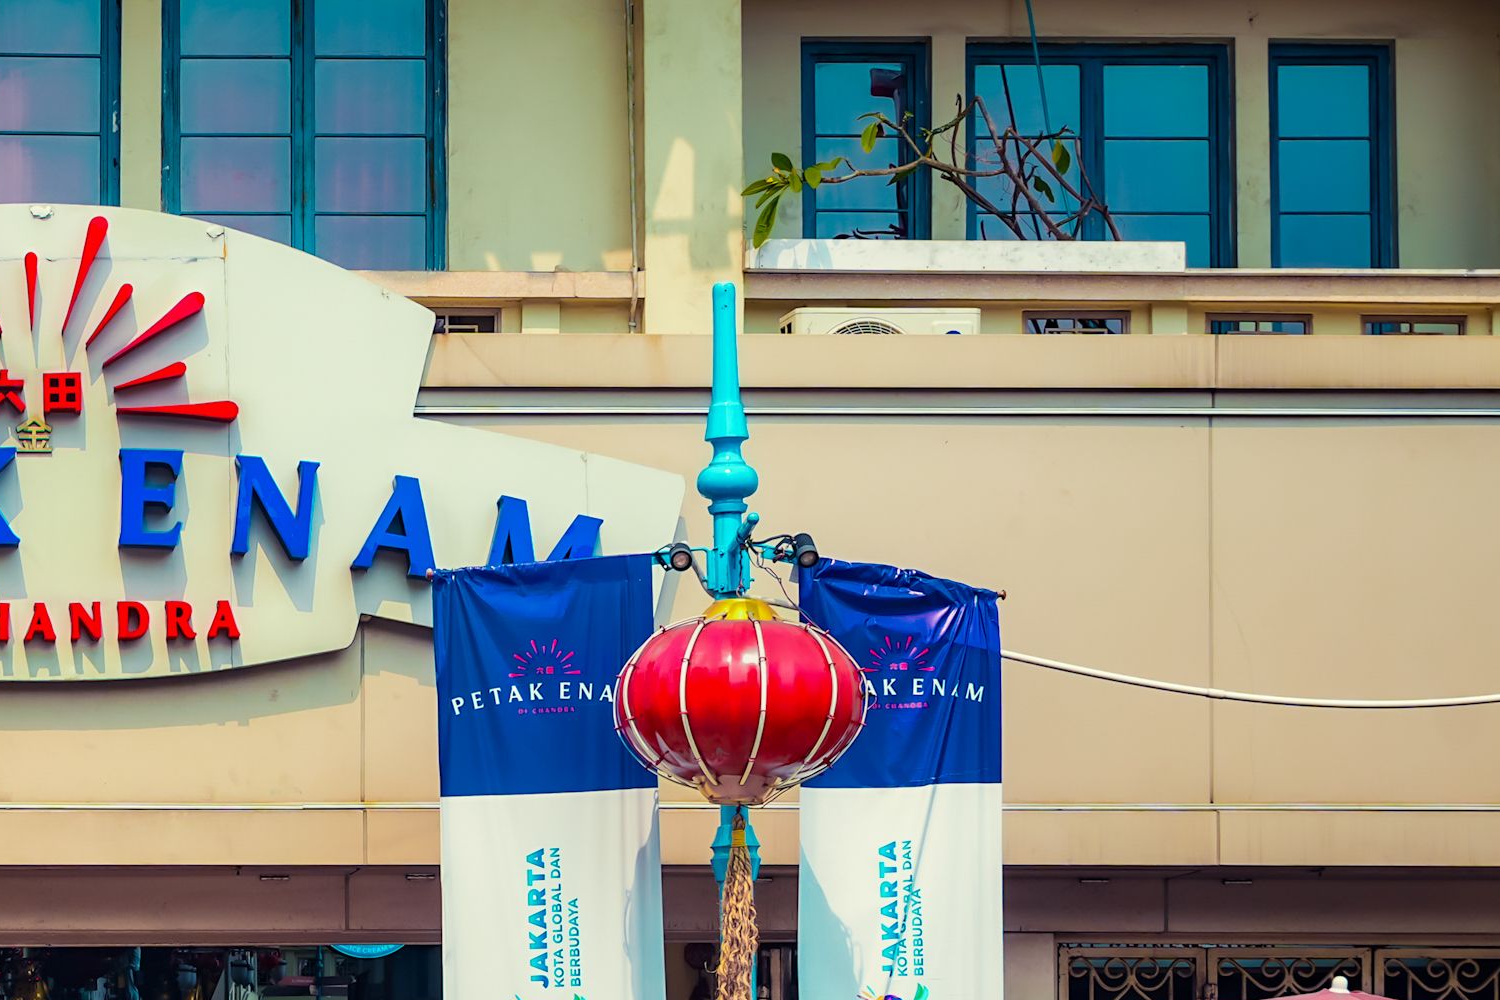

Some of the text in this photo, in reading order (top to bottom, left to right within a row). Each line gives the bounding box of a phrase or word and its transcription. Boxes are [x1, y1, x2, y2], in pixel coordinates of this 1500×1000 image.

[118, 446, 604, 580] ENAM
[451, 681, 614, 716] PETAK ENA
[532, 706, 575, 714] CHANDRA
[902, 840, 912, 871] DAN
[526, 848, 549, 989] JAKARTA
[549, 847, 565, 988] KOTA GLOBAL DAN
[568, 898, 581, 987] BERBUDAYA
[878, 841, 900, 978] JAKARTA
[911, 888, 924, 976] BERBUDAYA
[897, 938, 908, 977] KOTA
